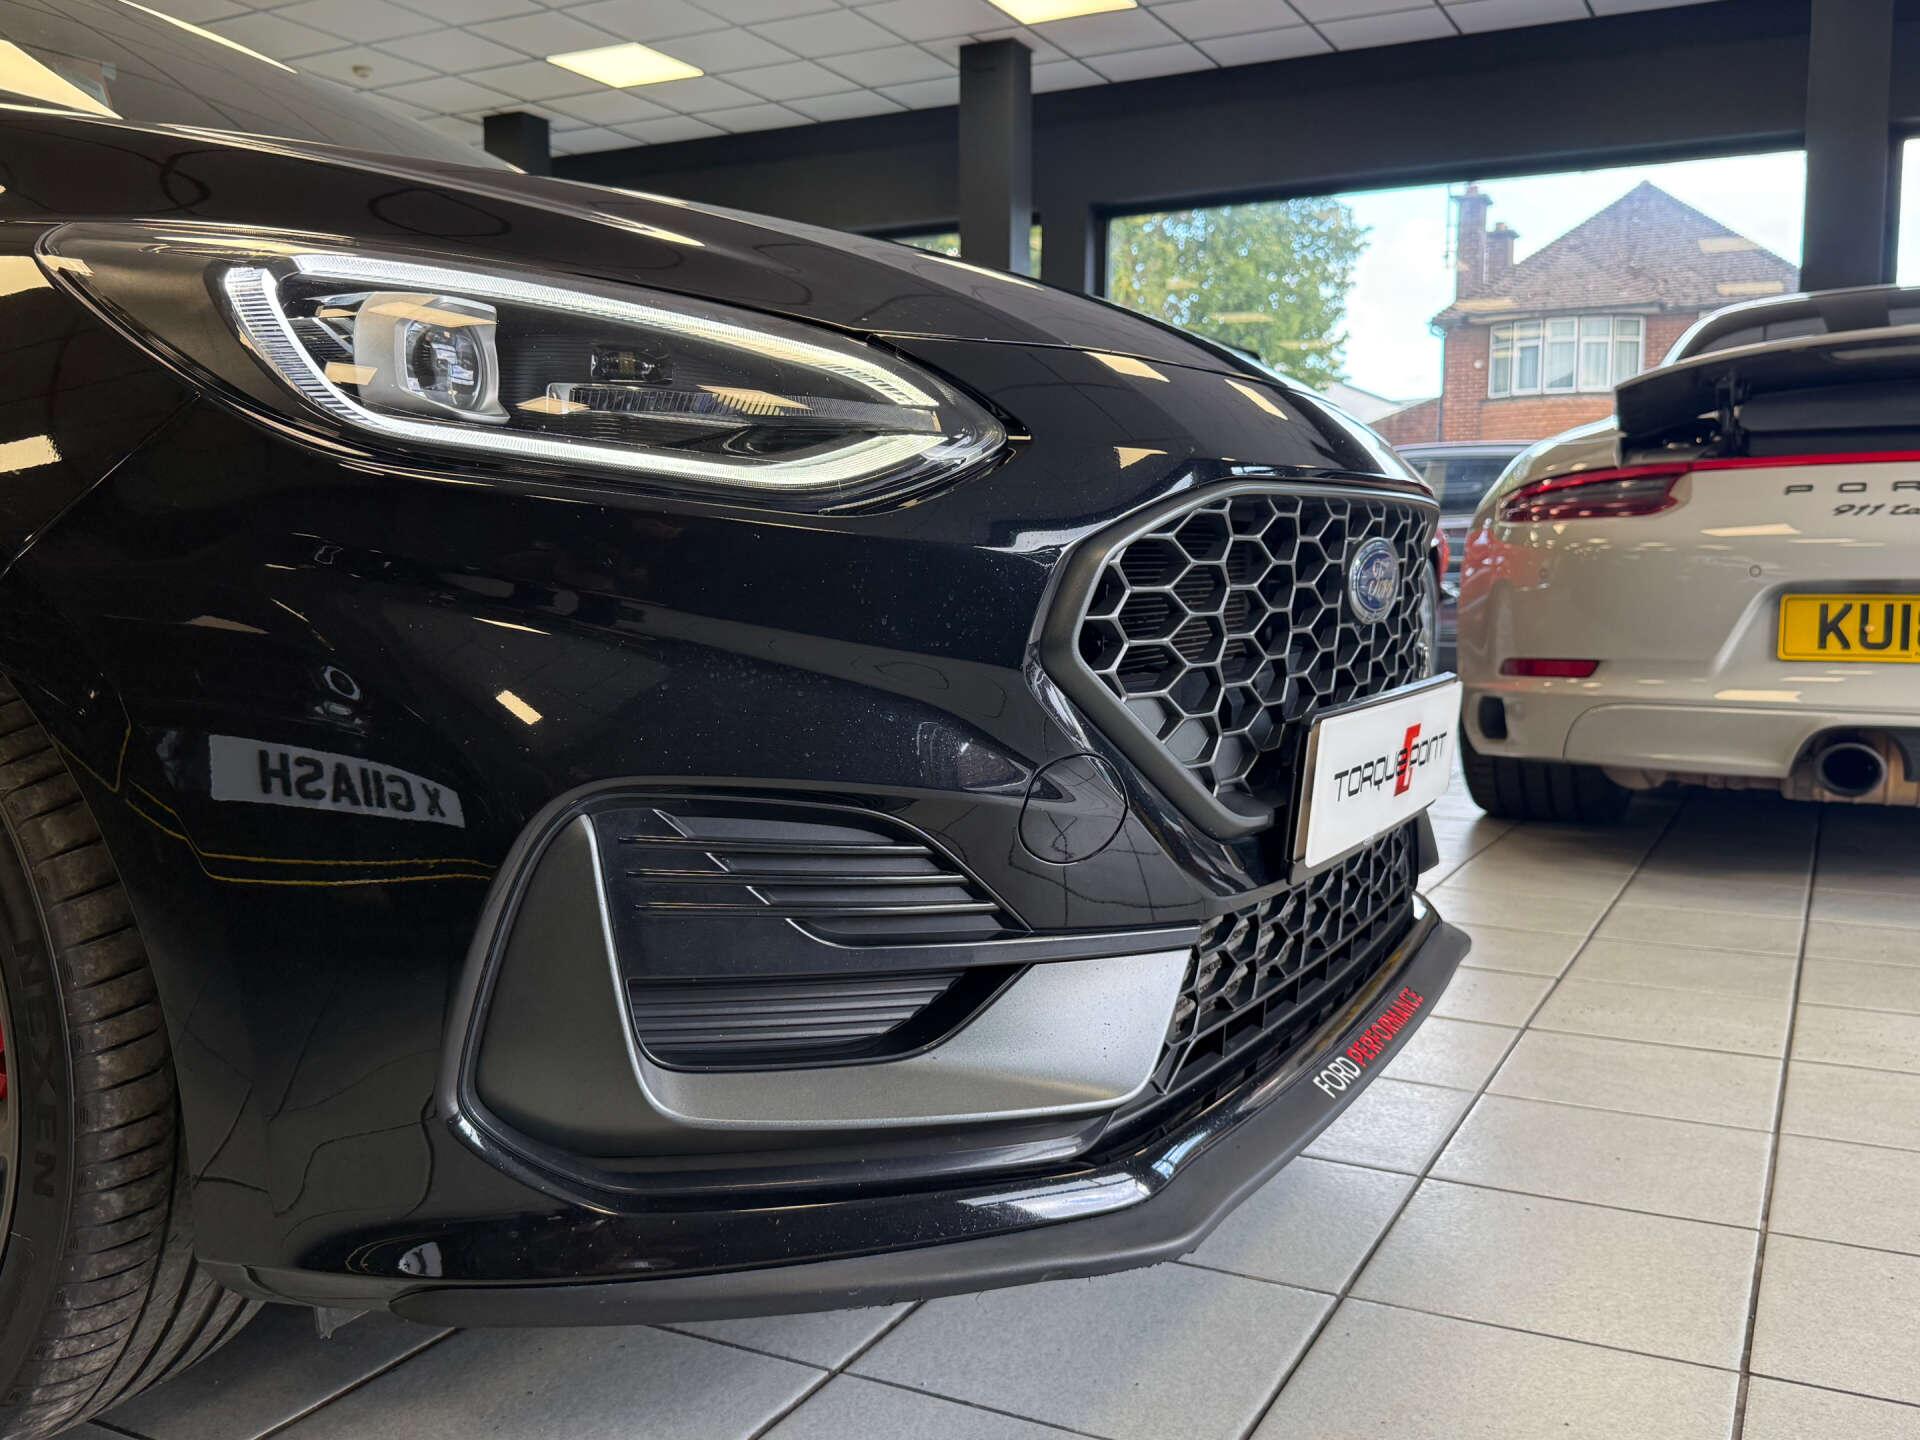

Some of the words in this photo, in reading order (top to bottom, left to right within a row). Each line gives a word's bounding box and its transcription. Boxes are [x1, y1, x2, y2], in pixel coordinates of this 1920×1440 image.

[1832, 503, 1885, 516] 911
[11, 937, 57, 1198] NEXEN
[1312, 1055, 1362, 1099] FORD
[1345, 985, 1425, 1069] PERFORMANCE
